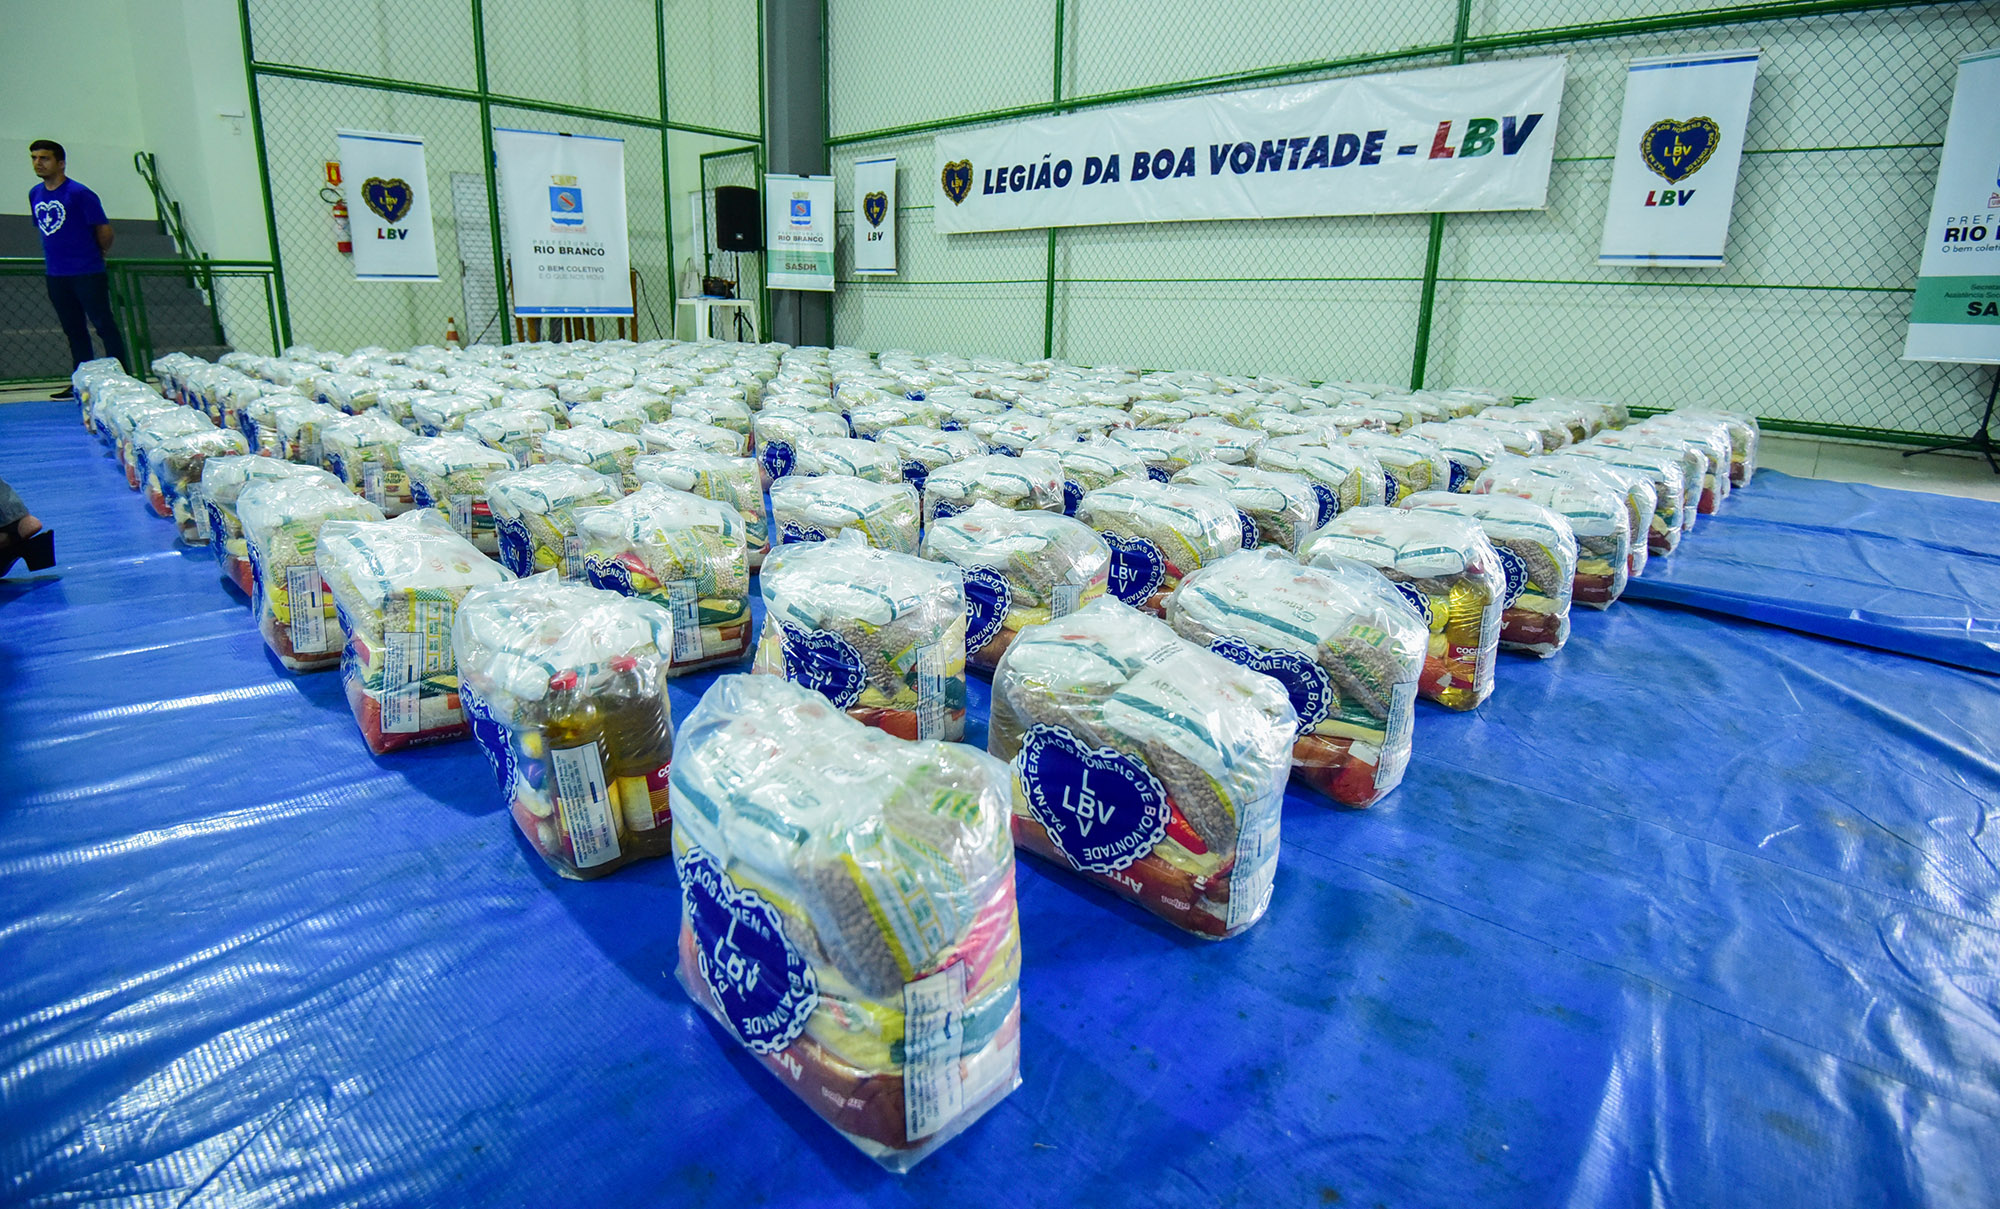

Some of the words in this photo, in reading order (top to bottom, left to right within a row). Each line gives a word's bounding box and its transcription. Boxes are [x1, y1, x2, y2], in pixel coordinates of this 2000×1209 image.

[983, 153, 1073, 195] LEGIÃO
[1082, 154, 1120, 185] DA
[1130, 146, 1196, 181] BOA
[1209, 129, 1388, 175] VONTADE
[1428, 114, 1544, 160] LBV
[1644, 189, 1696, 207] LBV
[1946, 214, 2000, 225] PREF
[377, 228, 408, 240] LBV
[793, 235, 824, 243] BRANCO
[867, 231, 884, 241] LBV
[1943, 225, 1988, 242] RIO
[533, 245, 555, 255] RIO
[558, 246, 606, 256] BRANCO
[566, 265, 605, 273] COLETIVO
[785, 262, 817, 271] SASDH
[1116, 543, 1148, 554] HOMENS
[1146, 551, 1157, 564] DE
[1110, 564, 1138, 582] LBV
[1149, 565, 1159, 582] BOA
[1504, 560, 1518, 574] DE
[991, 580, 1003, 594] DE
[965, 601, 982, 618] BV
[993, 595, 1005, 616] BOA
[966, 617, 998, 646] VONTADE
[801, 639, 839, 651] HOMENS
[1223, 646, 1247, 660] AOS
[1246, 655, 1301, 674] HOMENS
[1300, 671, 1318, 690] DE
[1301, 692, 1319, 717] BOA
[1046, 736, 1075, 754] AOS
[1028, 737, 1048, 784] TERRA
[1076, 752, 1135, 781] HOMENS
[1033, 784, 1048, 807] NA
[1134, 781, 1154, 803] DE
[1062, 785, 1116, 825] LBV
[1041, 805, 1066, 833] PAZ
[1134, 805, 1157, 834] BOA
[1082, 831, 1144, 861] VONTADE
